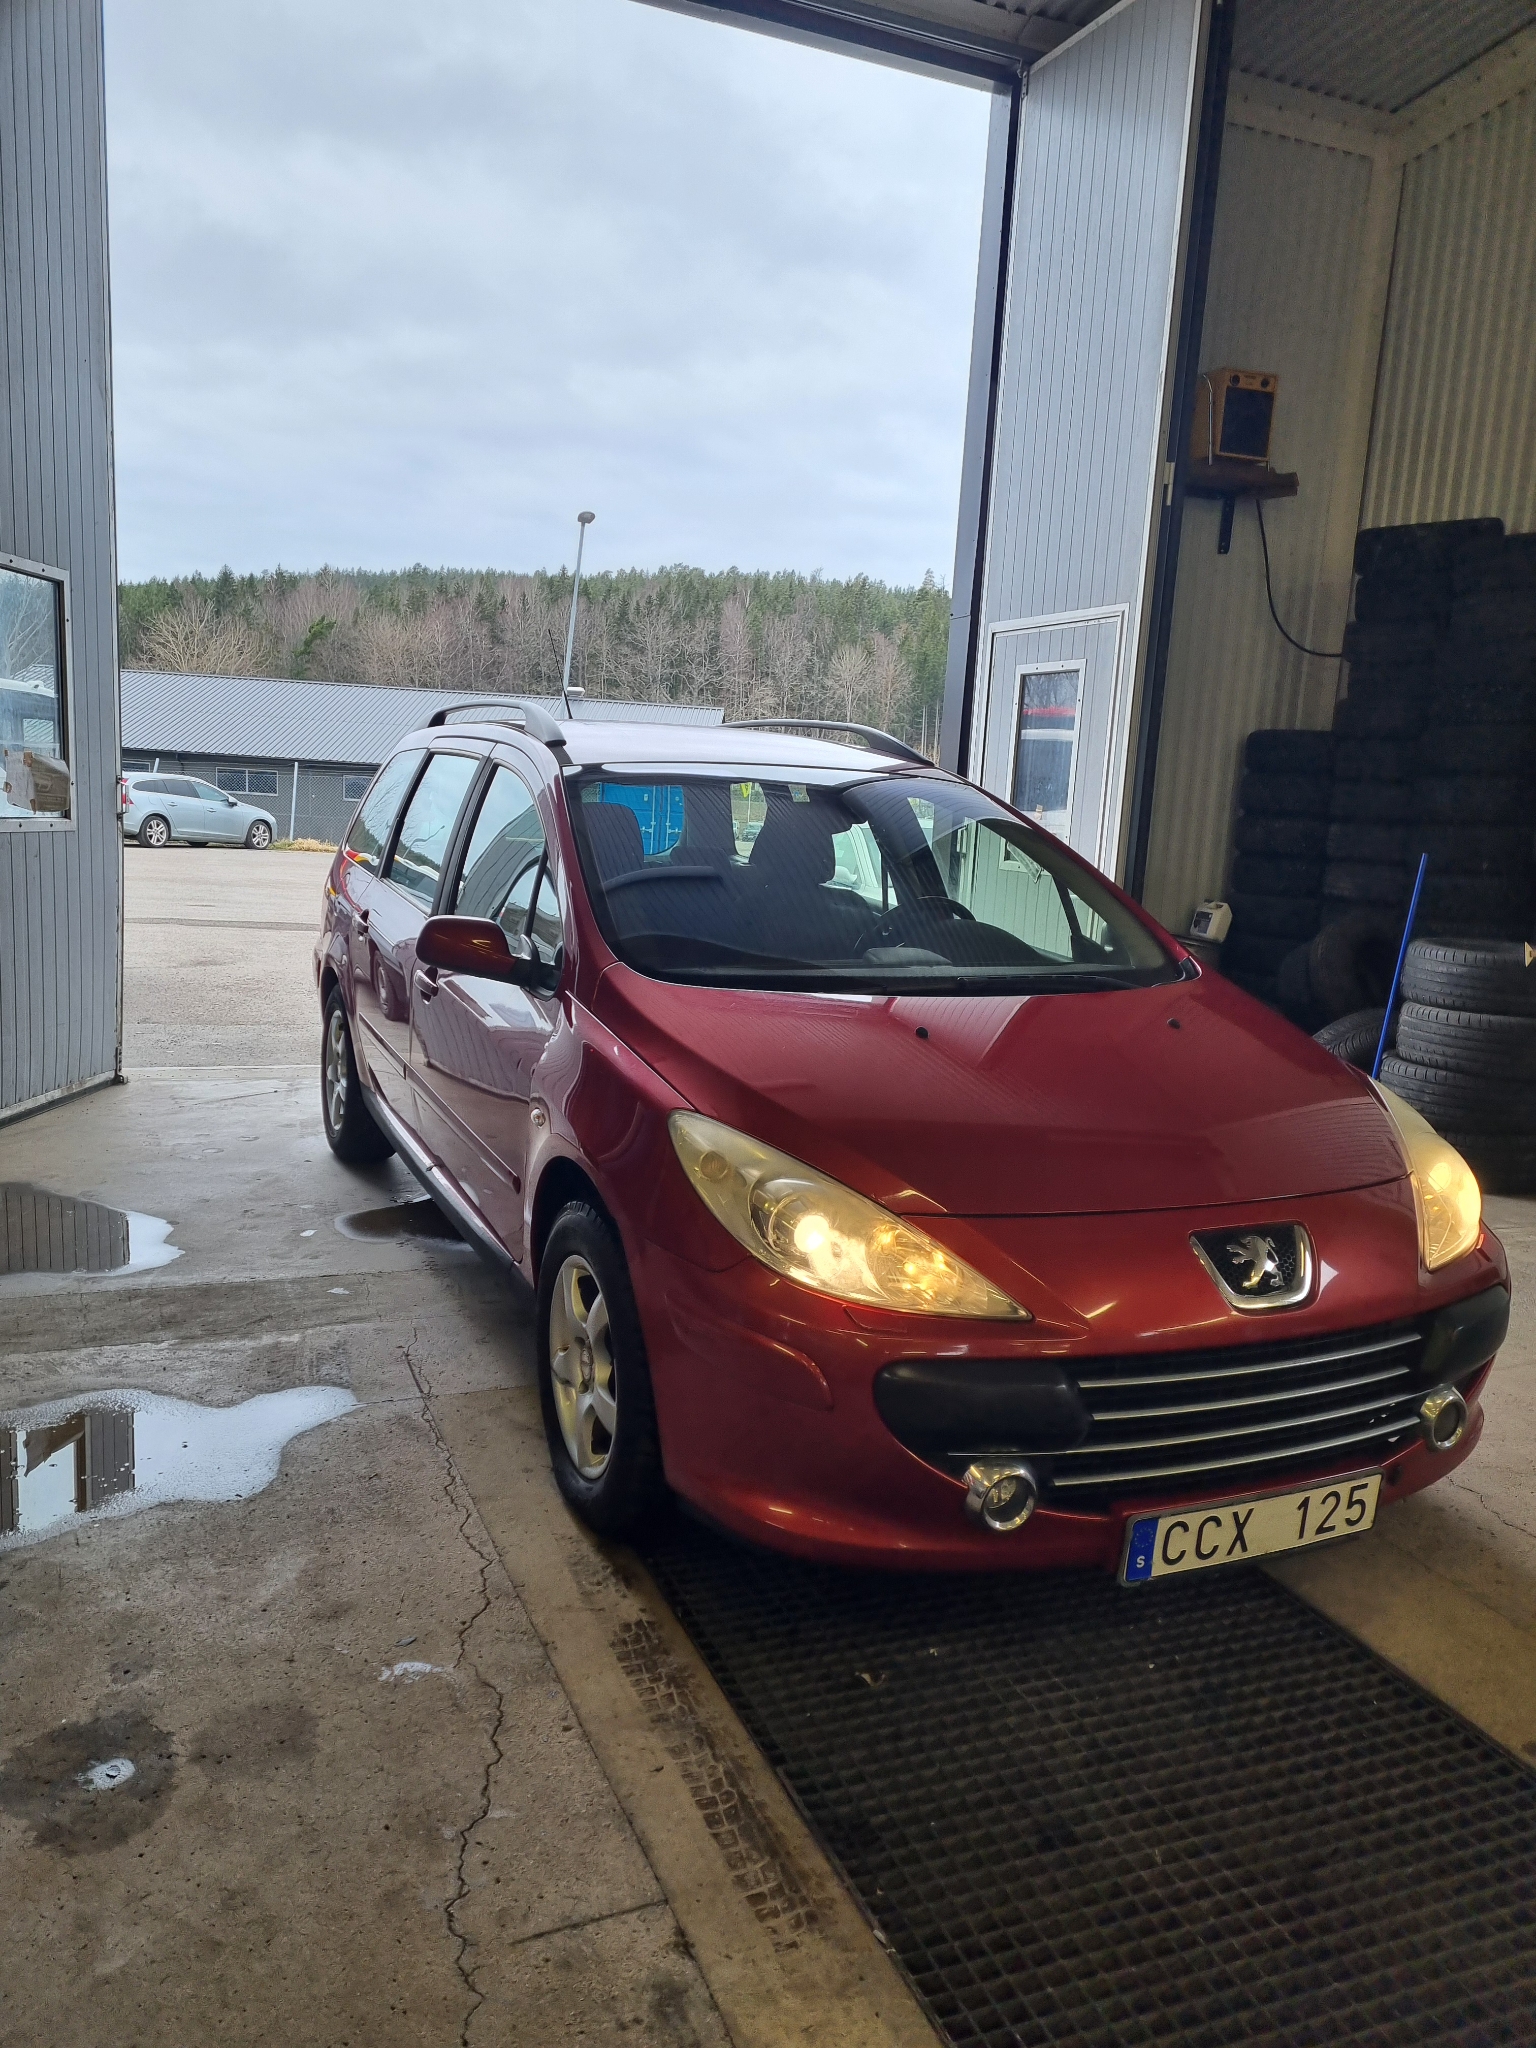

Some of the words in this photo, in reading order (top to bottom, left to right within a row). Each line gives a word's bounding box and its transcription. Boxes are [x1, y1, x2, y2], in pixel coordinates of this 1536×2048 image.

[1162, 1508, 1254, 1566] CCX
[1297, 1483, 1369, 1540] 125
[1136, 1555, 1145, 1568] S
